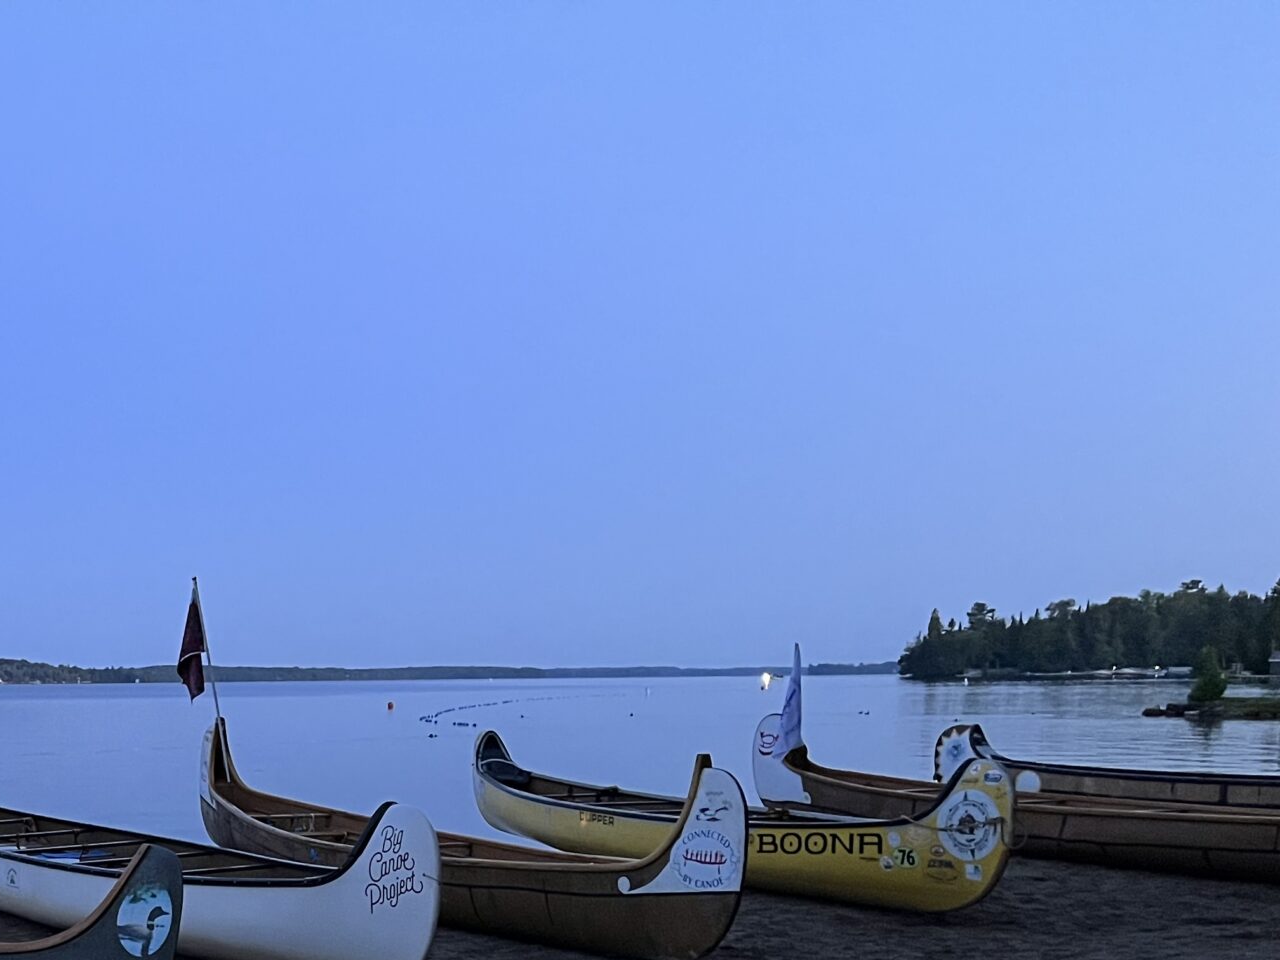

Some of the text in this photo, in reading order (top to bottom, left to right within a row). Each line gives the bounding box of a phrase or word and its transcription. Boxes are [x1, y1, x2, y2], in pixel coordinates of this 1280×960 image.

[579, 811, 614, 826] CLIPPER
[381, 825, 404, 853] Big
[682, 829, 731, 849] CONNECTED
[369, 851, 415, 882] Canoe
[897, 848, 916, 866] 76
[682, 874, 725, 889] BY CANOE
[365, 872, 423, 914] Project
